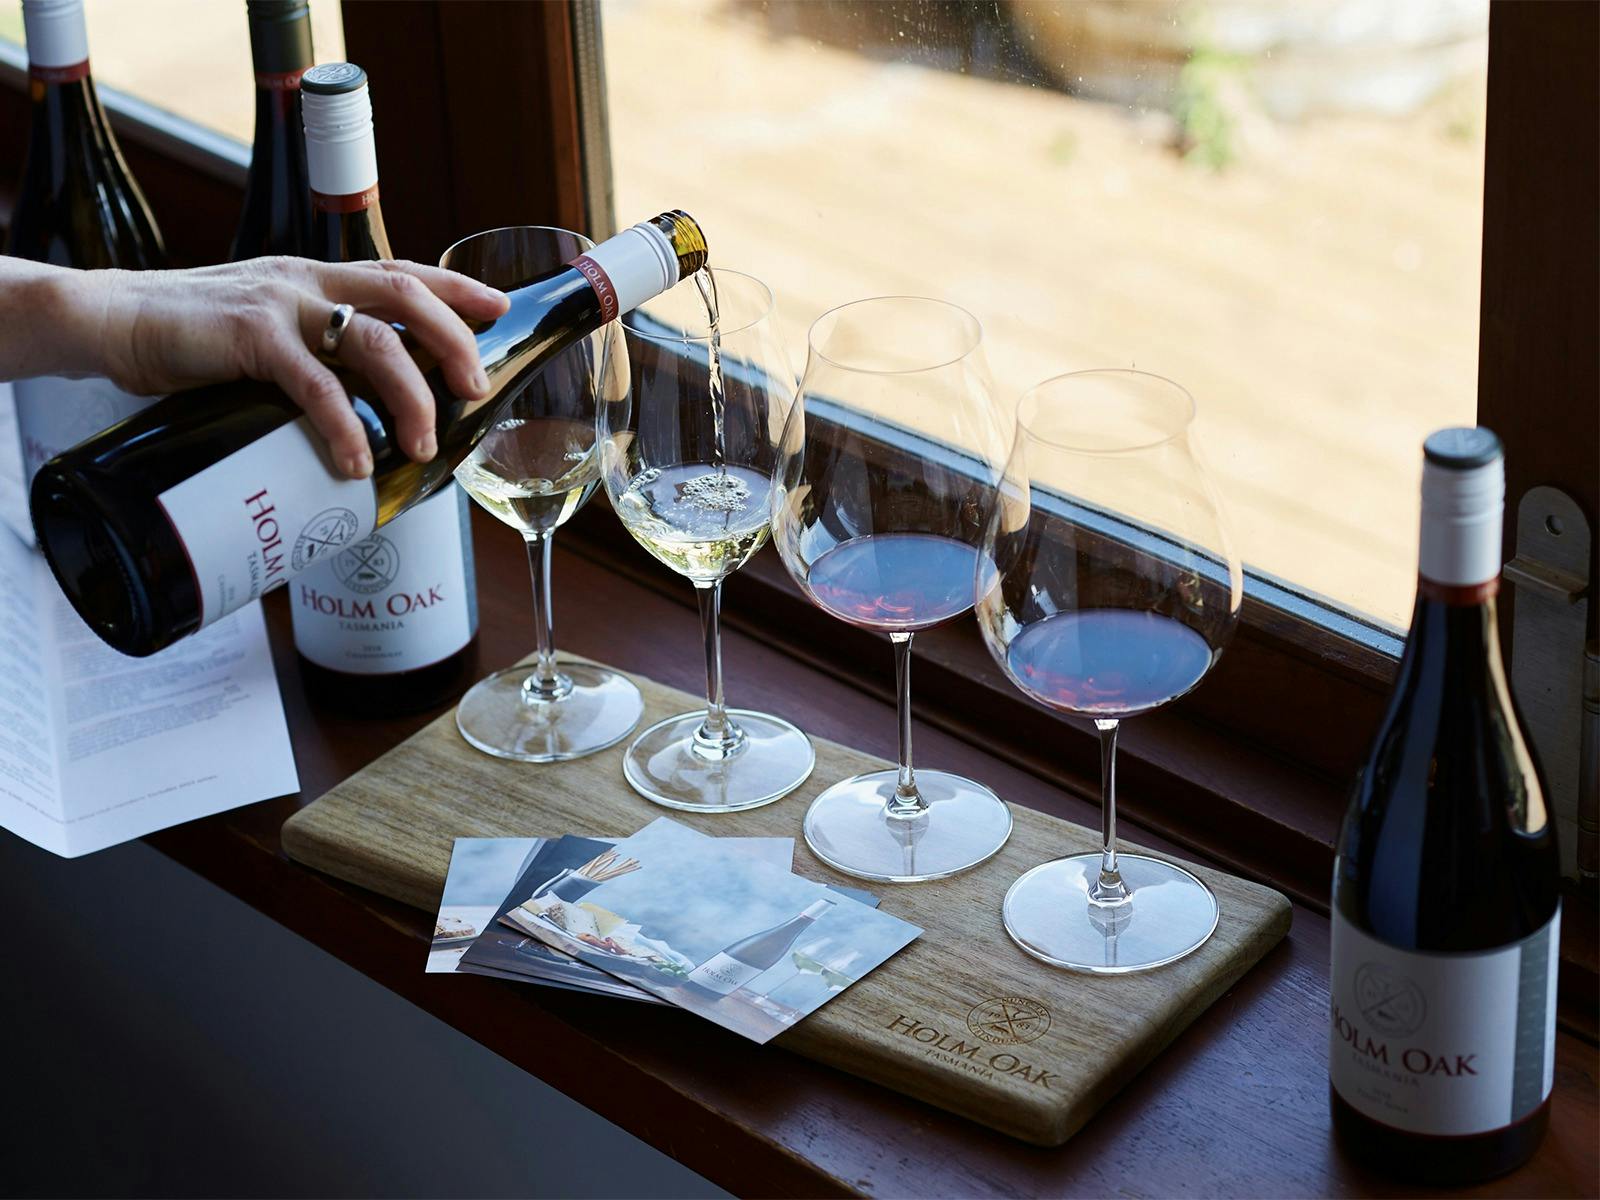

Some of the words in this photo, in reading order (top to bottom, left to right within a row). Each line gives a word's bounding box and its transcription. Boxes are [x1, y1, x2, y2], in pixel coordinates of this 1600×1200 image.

[580, 260, 608, 294] HOLM
[244, 489, 286, 579] HOLM
[301, 585, 376, 619] HOLM
[386, 582, 445, 616] OAK
[339, 621, 404, 632] TASMANIA
[886, 1014, 981, 1060] HOLM
[989, 1053, 1061, 1089] OAK
[924, 1049, 994, 1080] TASMANIA
[1401, 1048, 1478, 1077] OAK
